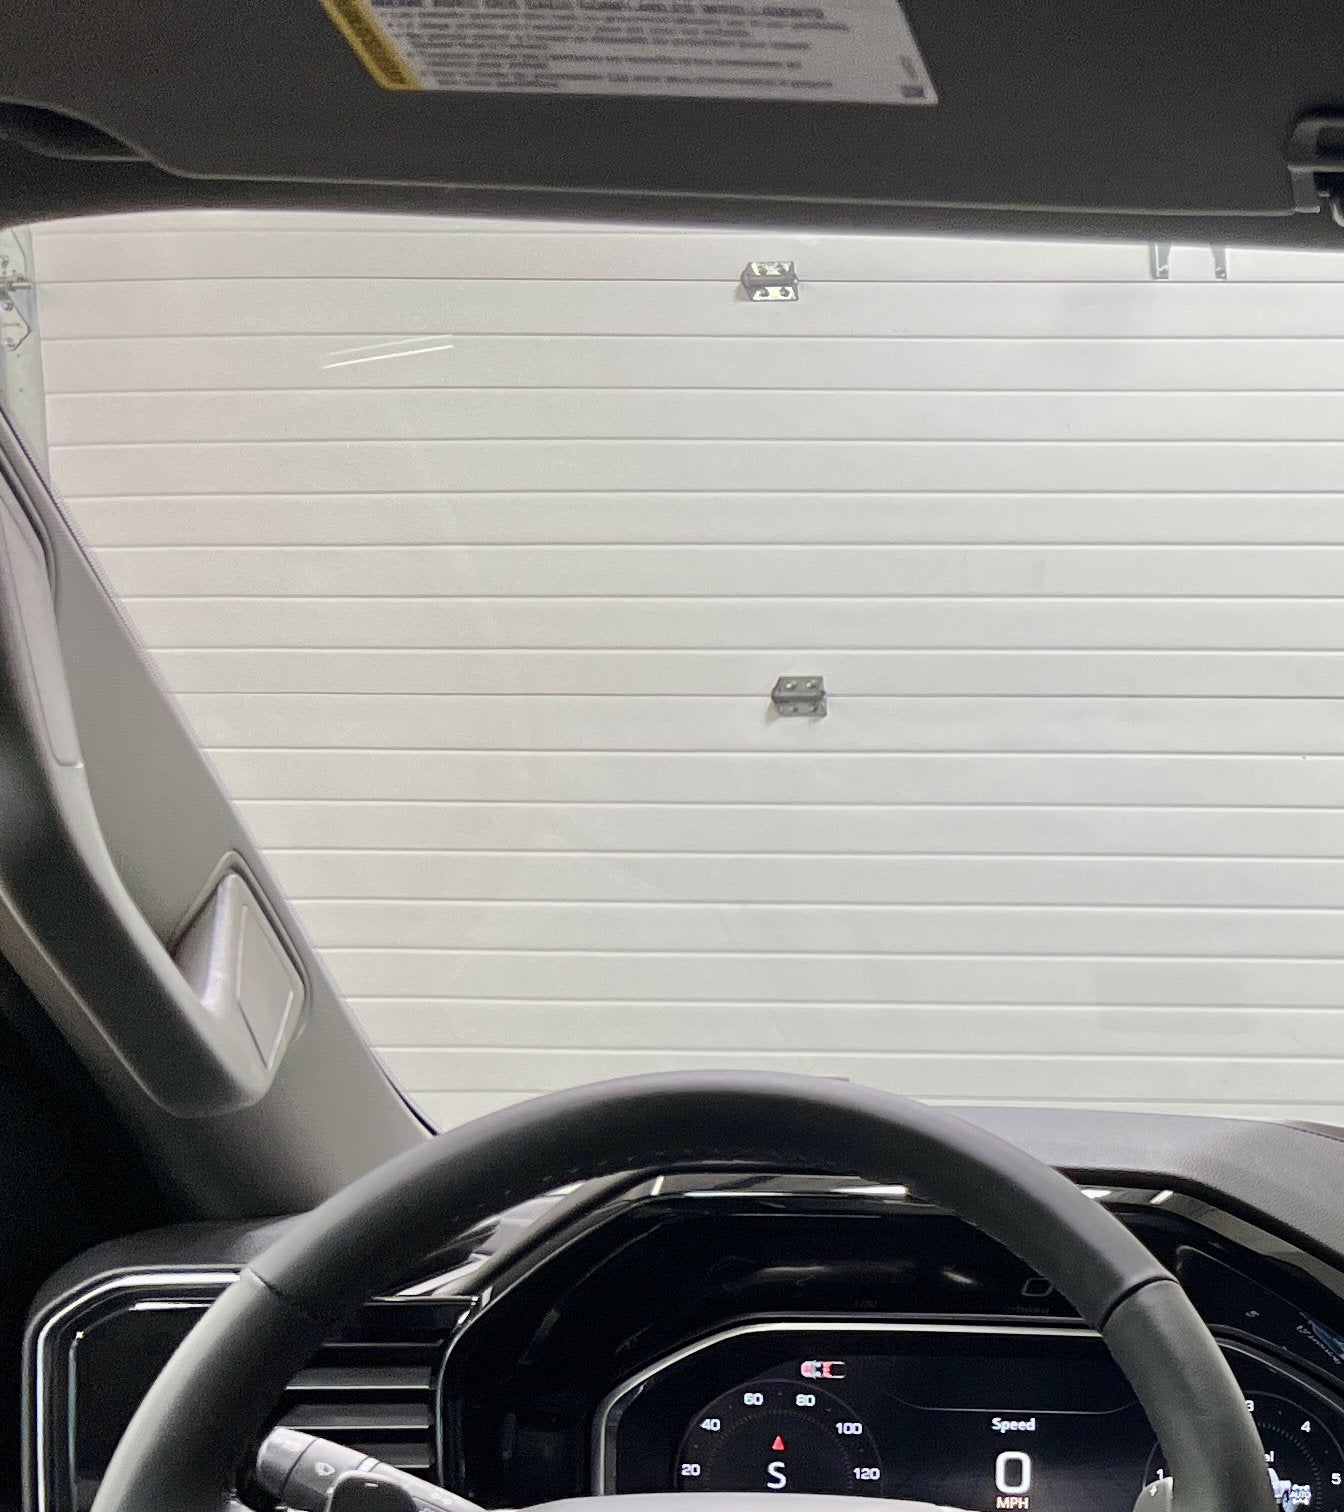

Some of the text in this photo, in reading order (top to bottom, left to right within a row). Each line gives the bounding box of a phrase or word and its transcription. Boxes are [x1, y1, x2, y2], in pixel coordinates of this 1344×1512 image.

[744, 1393, 763, 1405] 60
[796, 1394, 815, 1406] 80
[700, 1419, 720, 1431] 40
[836, 1423, 862, 1434] 100
[992, 1418, 1035, 1433] Speed
[1301, 1421, 1310, 1432] 4
[682, 1464, 700, 1476] 20
[767, 1462, 786, 1489] S
[854, 1468, 880, 1479] 120
[996, 1452, 1031, 1494] 0
[1331, 1473, 1341, 1485] 5
[996, 1497, 1029, 1509] MPH
